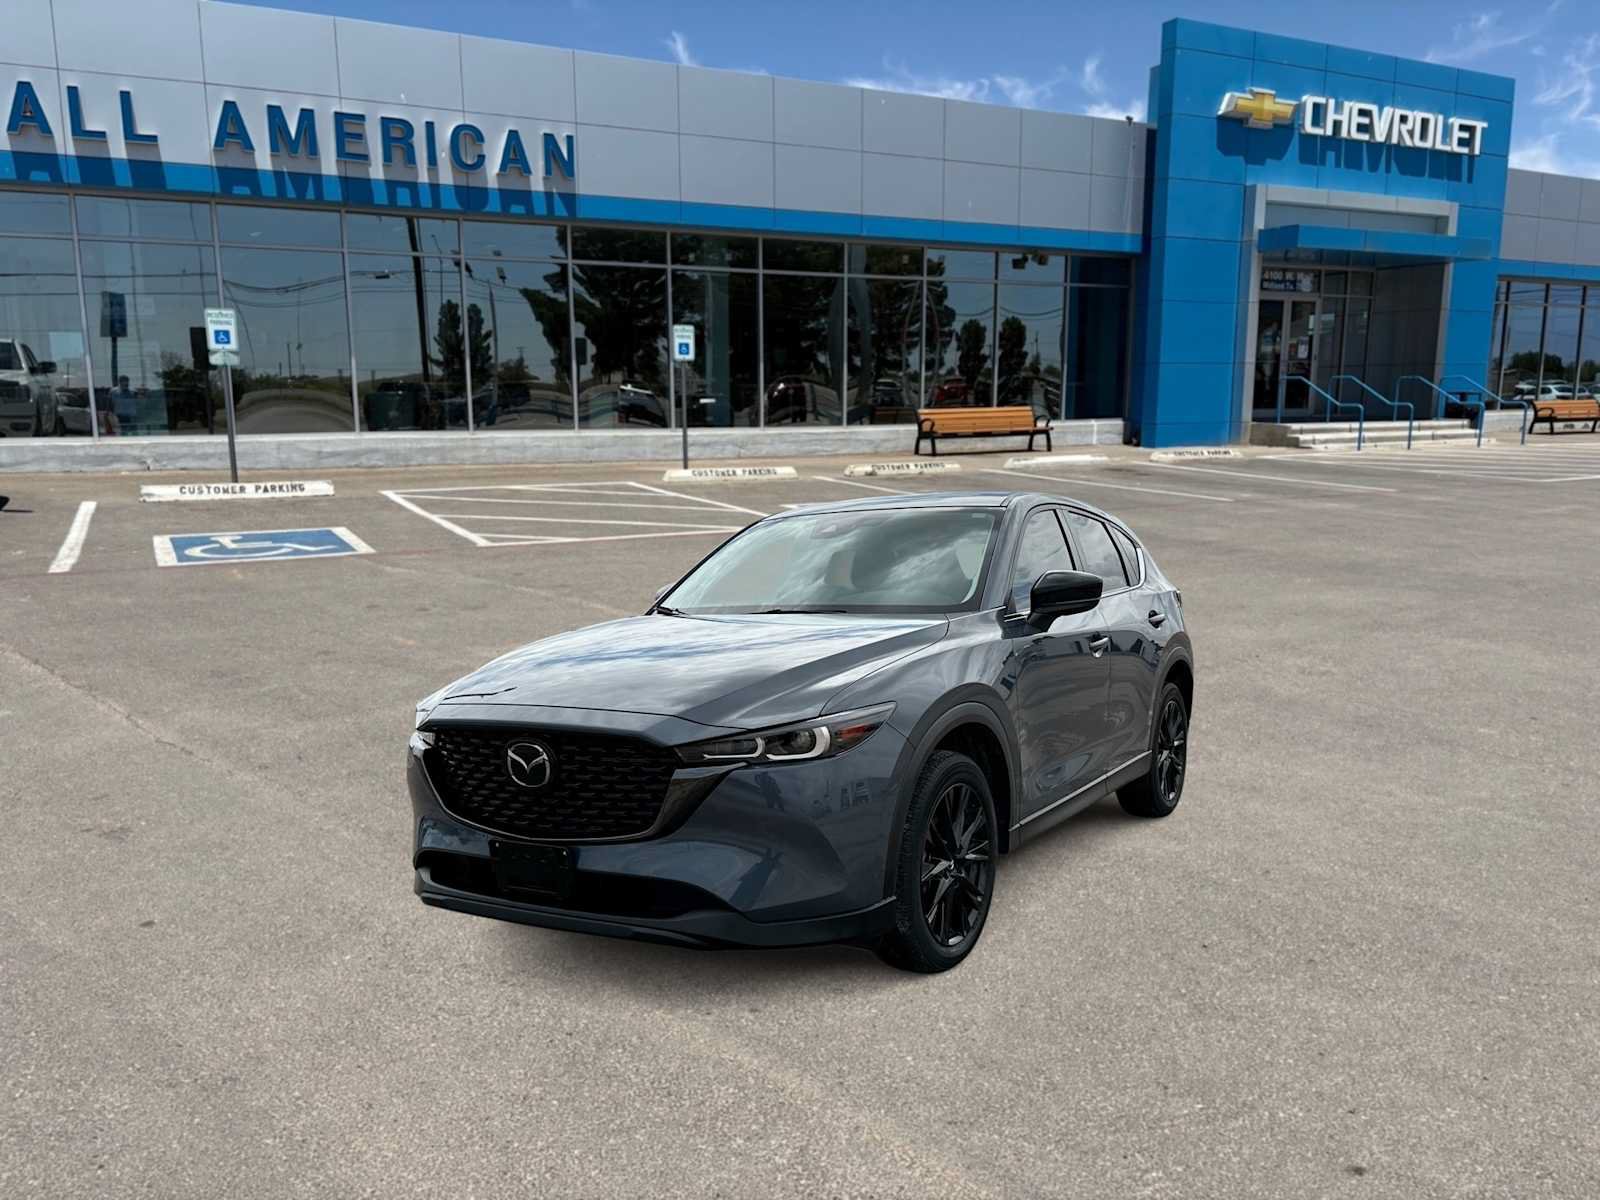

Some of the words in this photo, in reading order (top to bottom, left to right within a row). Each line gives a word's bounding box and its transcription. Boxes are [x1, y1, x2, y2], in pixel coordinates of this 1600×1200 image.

[6, 80, 159, 143] ALL
[213, 100, 575, 179] AMERICAN
[1301, 94, 1488, 155] CHEVROLET
[692, 469, 737, 477] CUSTOMER
[742, 468, 777, 476] PARKING
[871, 463, 910, 471] CUSTOMER
[179, 484, 247, 495] CUSTOMER
[254, 482, 306, 493] PARKING
